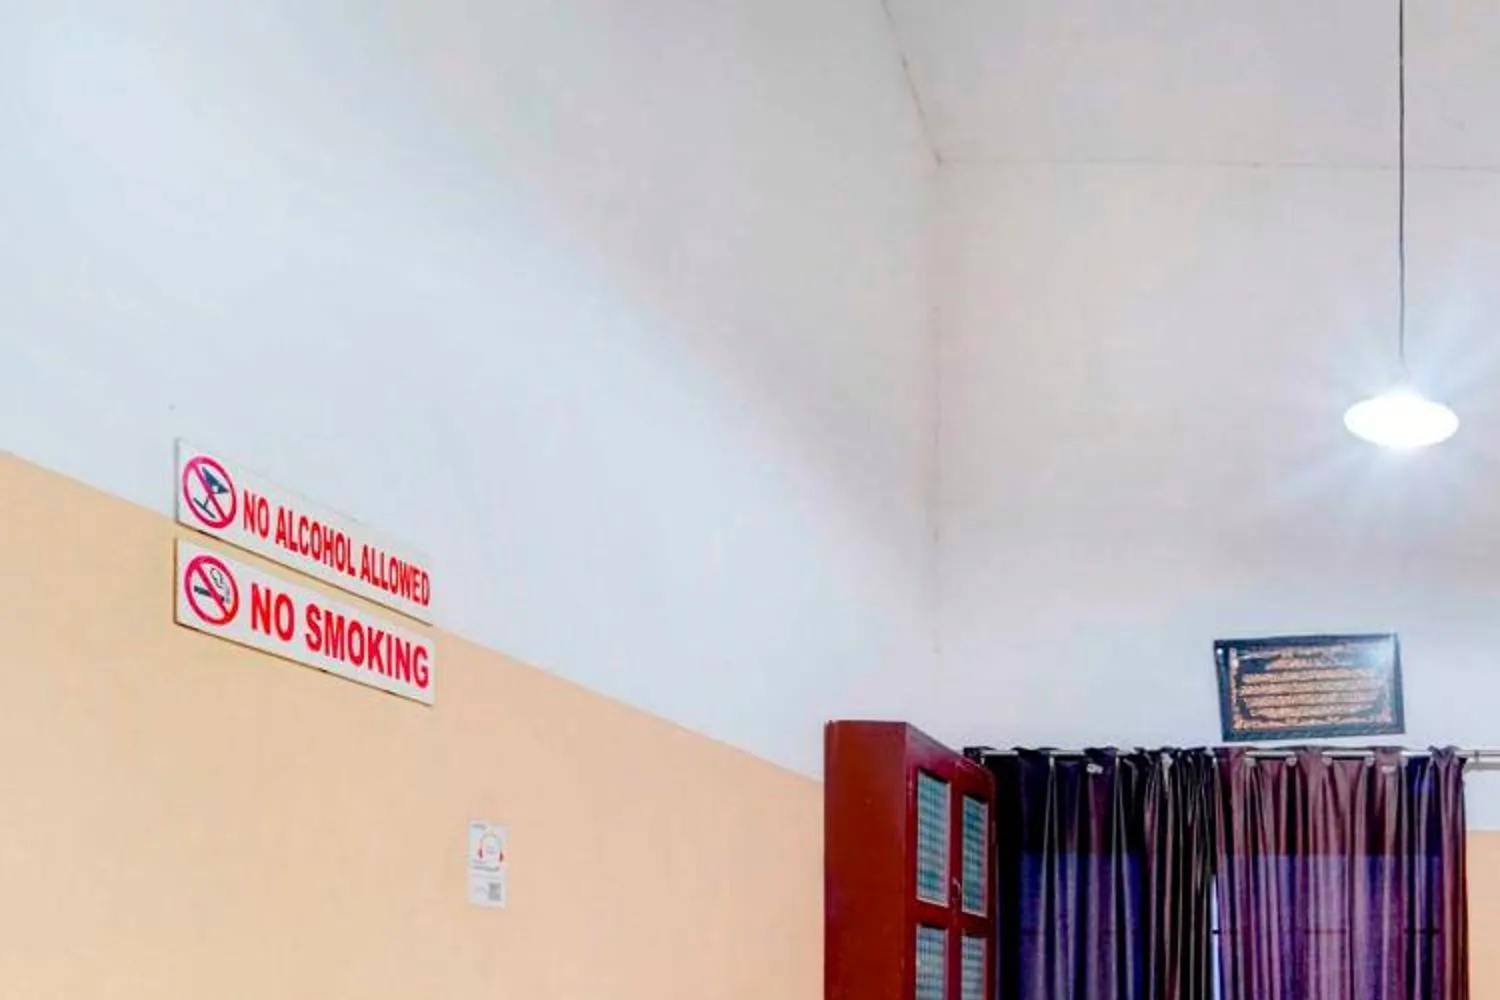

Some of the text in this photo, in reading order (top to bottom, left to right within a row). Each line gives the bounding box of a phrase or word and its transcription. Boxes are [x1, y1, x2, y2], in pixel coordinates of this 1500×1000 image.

[243, 489, 430, 607] NO ALCOHOL ALLOWED
[251, 582, 429, 689] NO SMOKING
